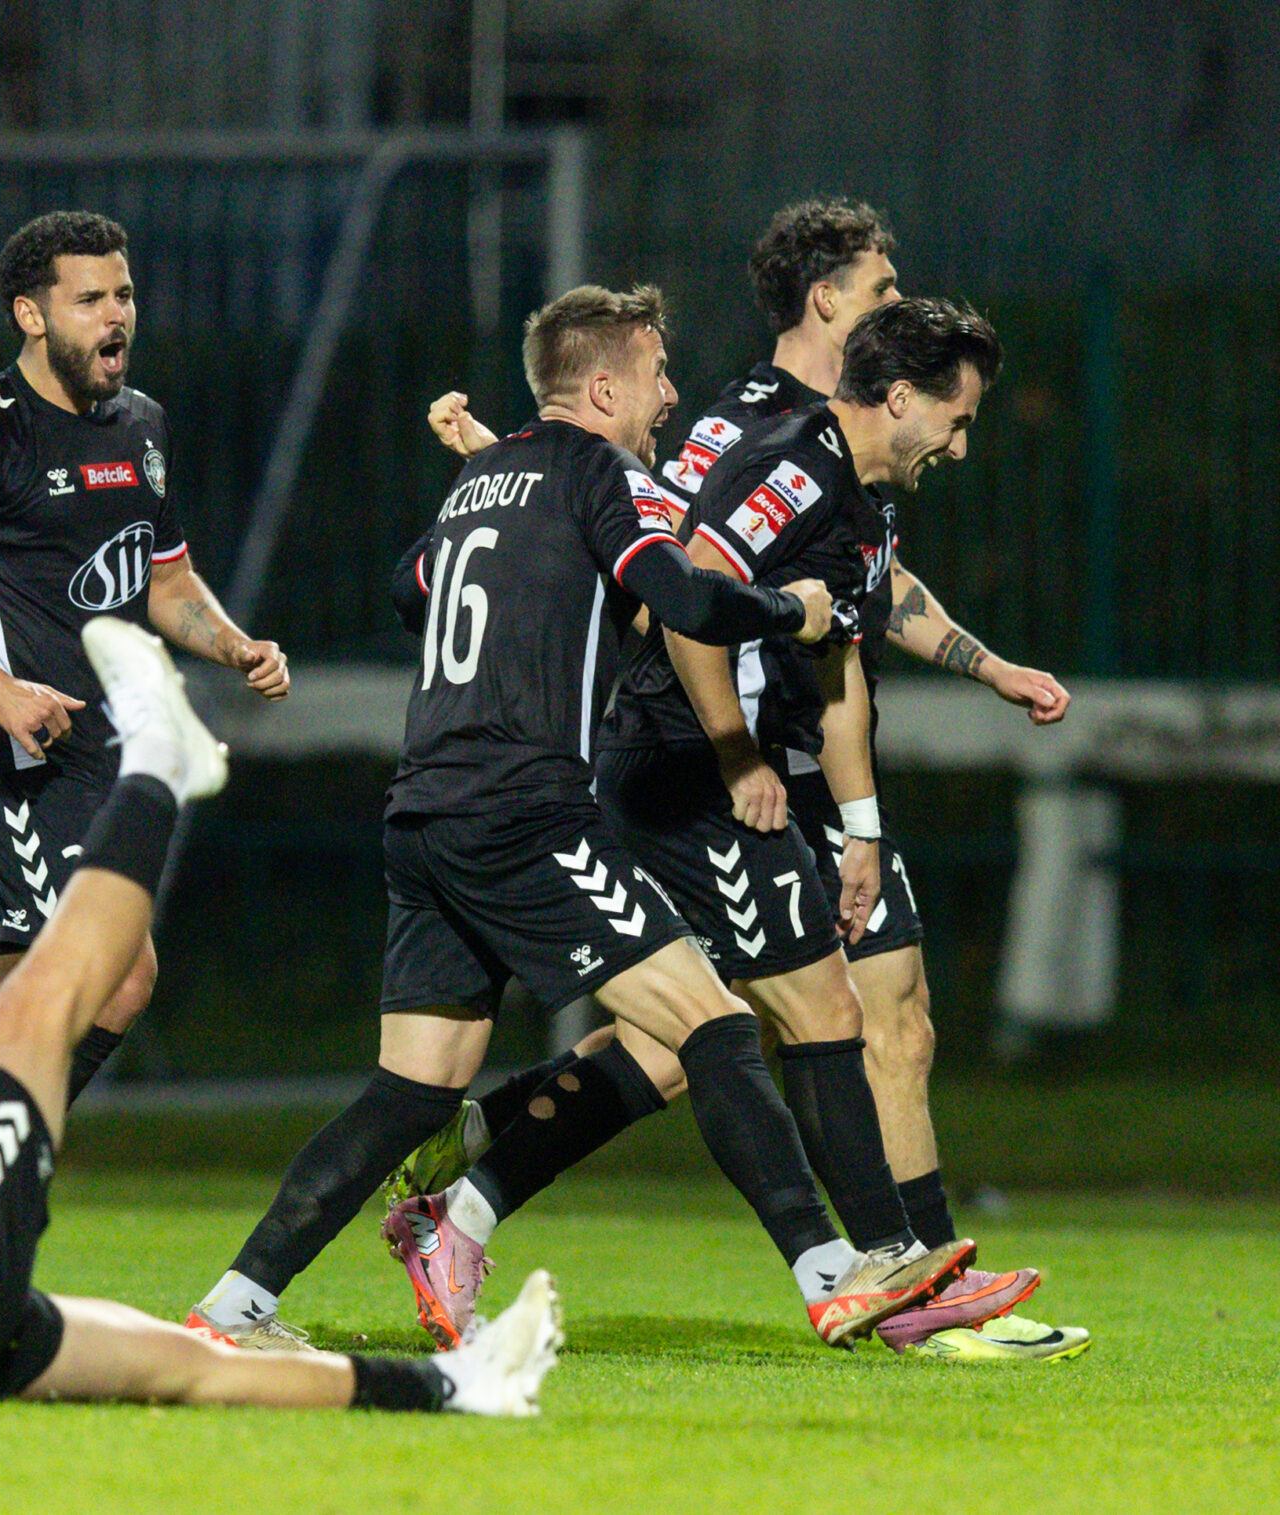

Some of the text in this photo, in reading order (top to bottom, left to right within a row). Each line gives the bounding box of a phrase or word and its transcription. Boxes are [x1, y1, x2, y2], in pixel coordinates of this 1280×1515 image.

[87, 465, 133, 485] Betclic
[753, 492, 787, 527] Betclic
[773, 479, 803, 508] SUZUKI
[421, 526, 499, 691] 16
[773, 870, 805, 938] 7
